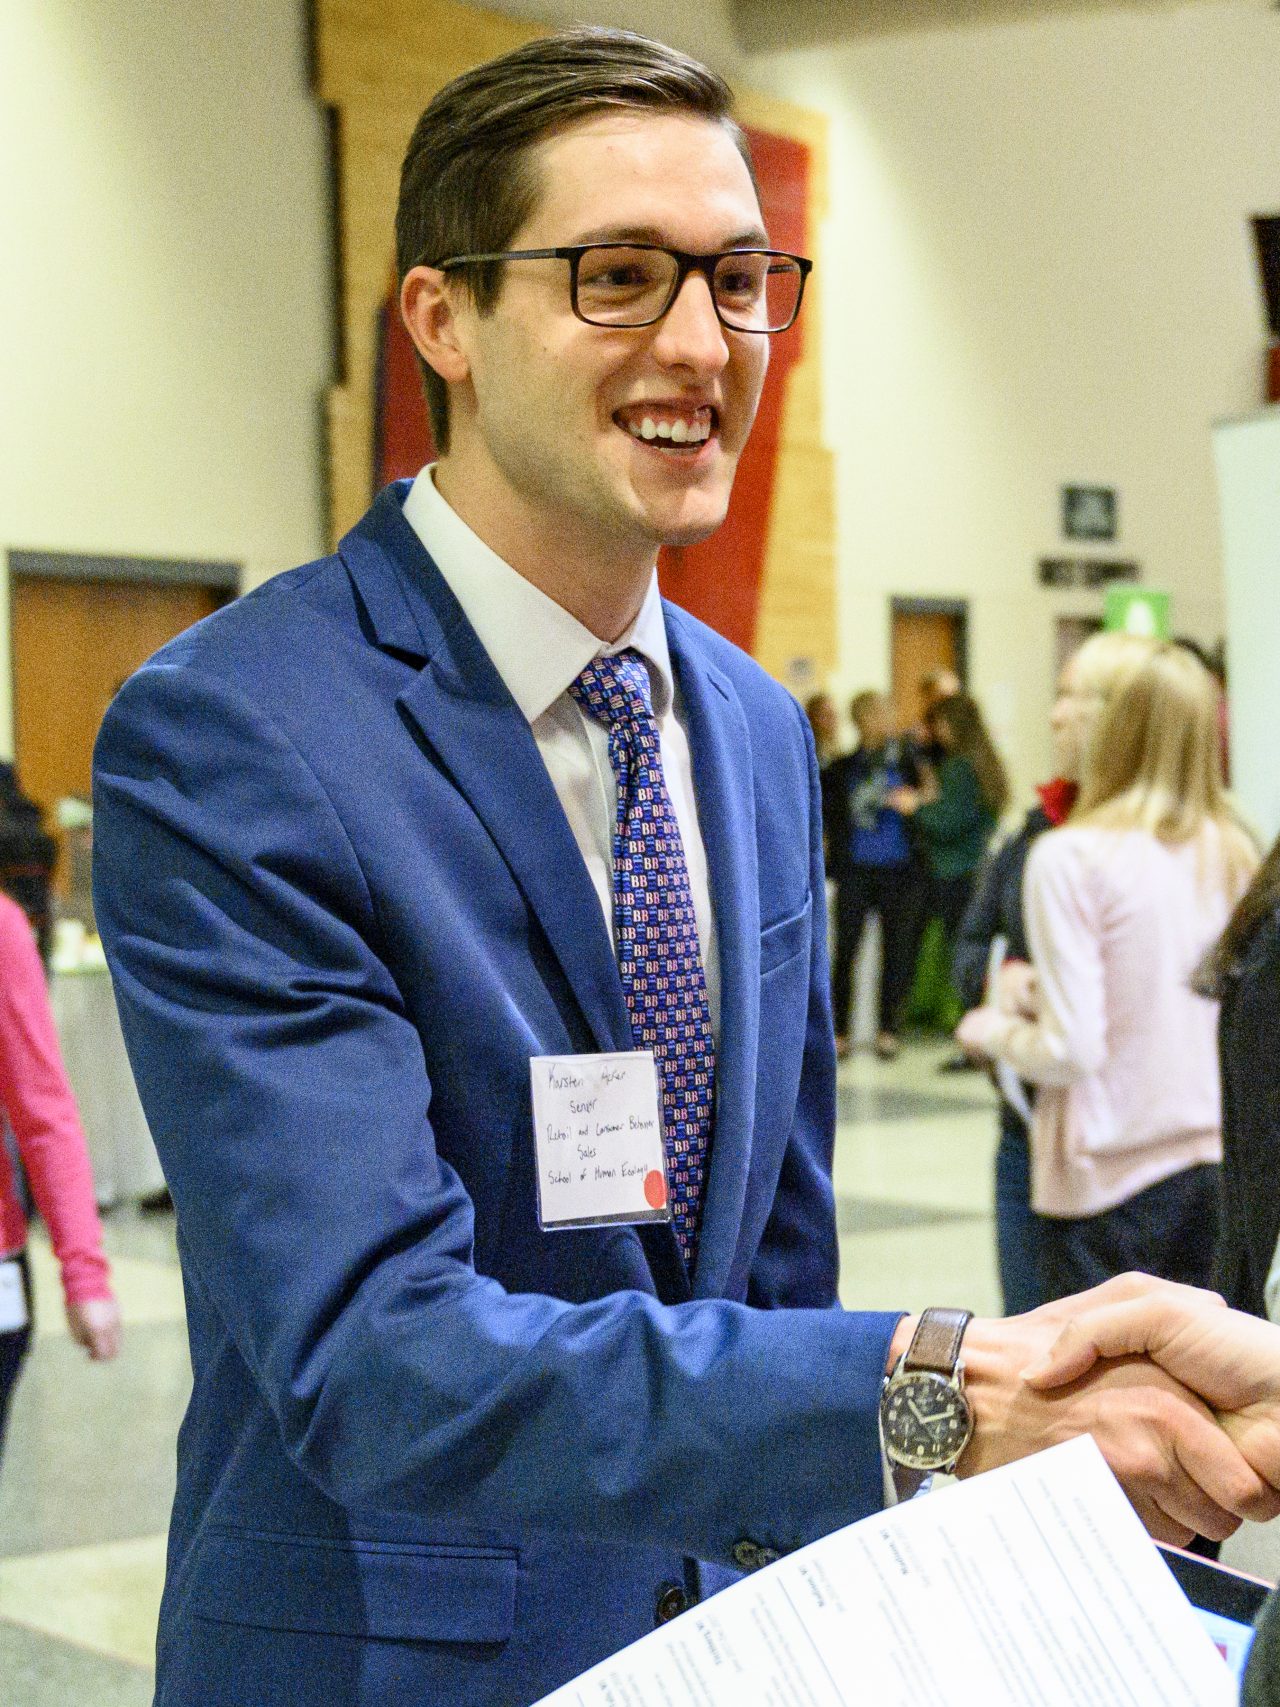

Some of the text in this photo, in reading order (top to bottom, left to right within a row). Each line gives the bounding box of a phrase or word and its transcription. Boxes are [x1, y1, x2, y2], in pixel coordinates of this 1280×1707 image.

[578, 1126, 589, 1136] and
[577, 1144, 597, 1160] Sales
[548, 1170, 572, 1185] School
[595, 1166, 616, 1180] Human
